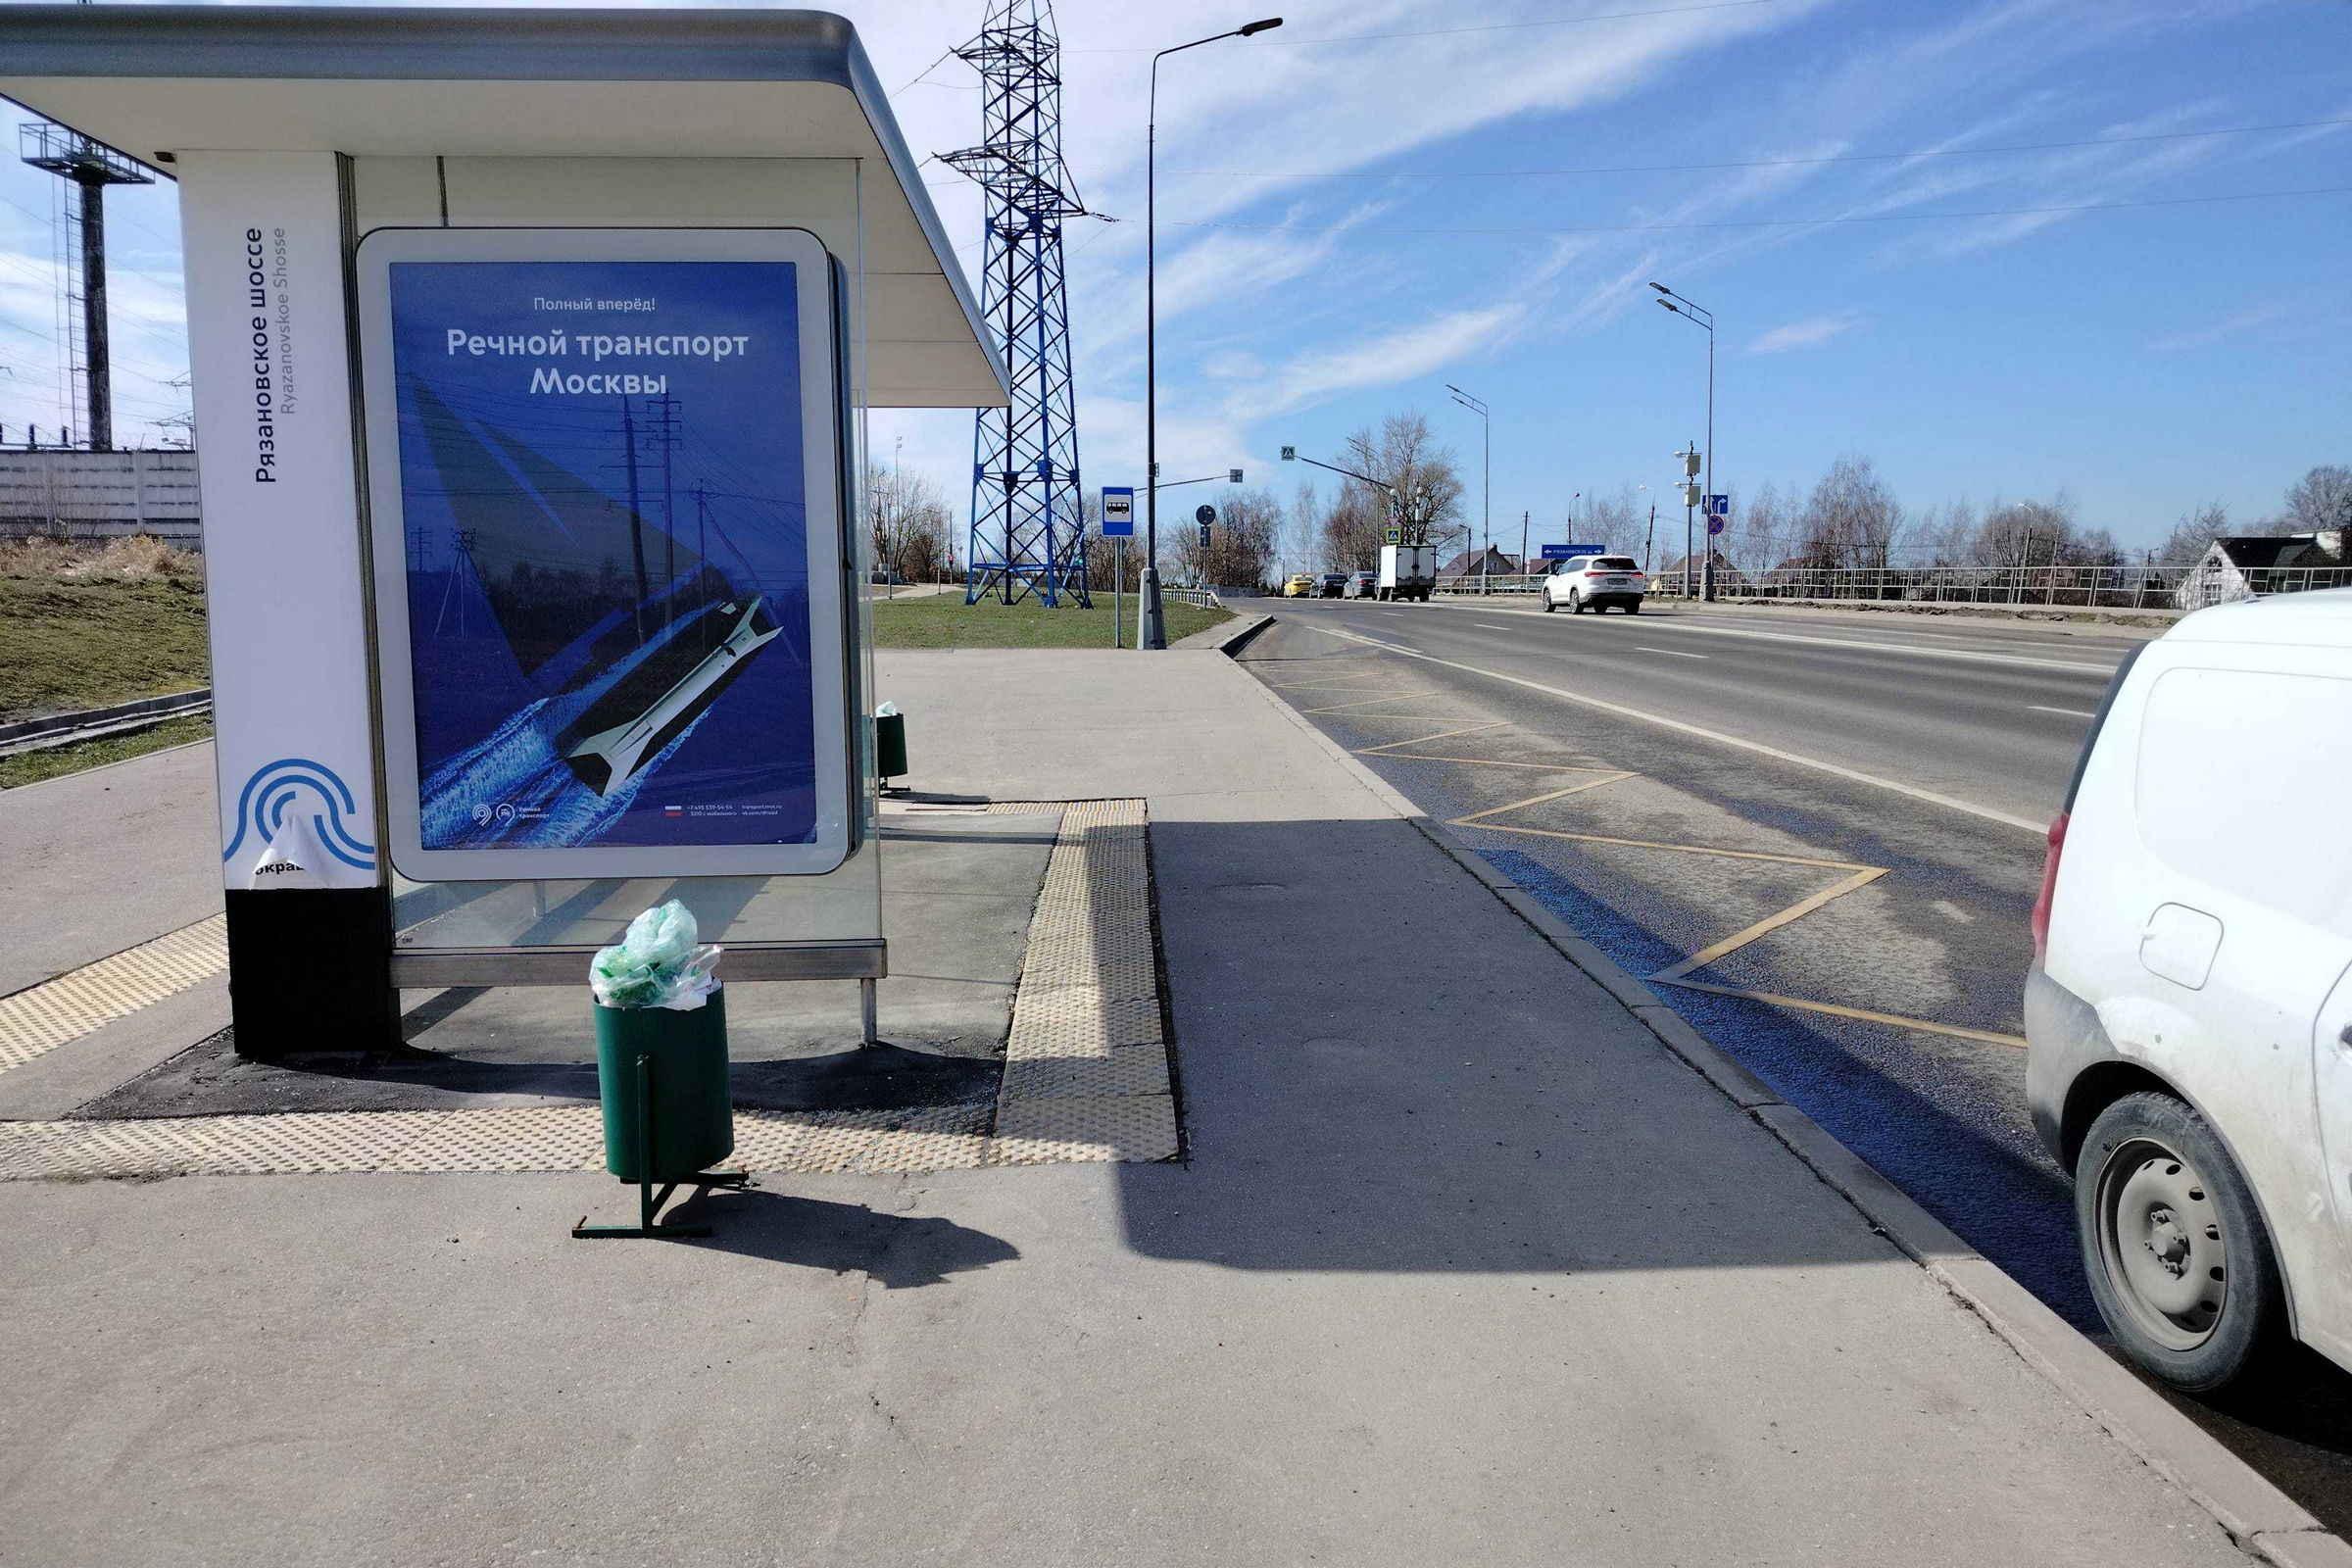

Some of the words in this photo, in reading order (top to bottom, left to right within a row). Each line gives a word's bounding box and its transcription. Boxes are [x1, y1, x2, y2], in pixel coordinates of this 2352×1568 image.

[246, 227, 267, 308] шоссе
[272, 227, 288, 288] Shosse
[534, 297, 592, 310] Полный
[597, 297, 656, 313] вперёд!
[275, 293, 298, 415] Ryazanovskoe
[447, 328, 567, 356] Речной
[575, 335, 749, 362] транспорт
[252, 317, 276, 483] Рязановское
[529, 368, 667, 394] Москвы
